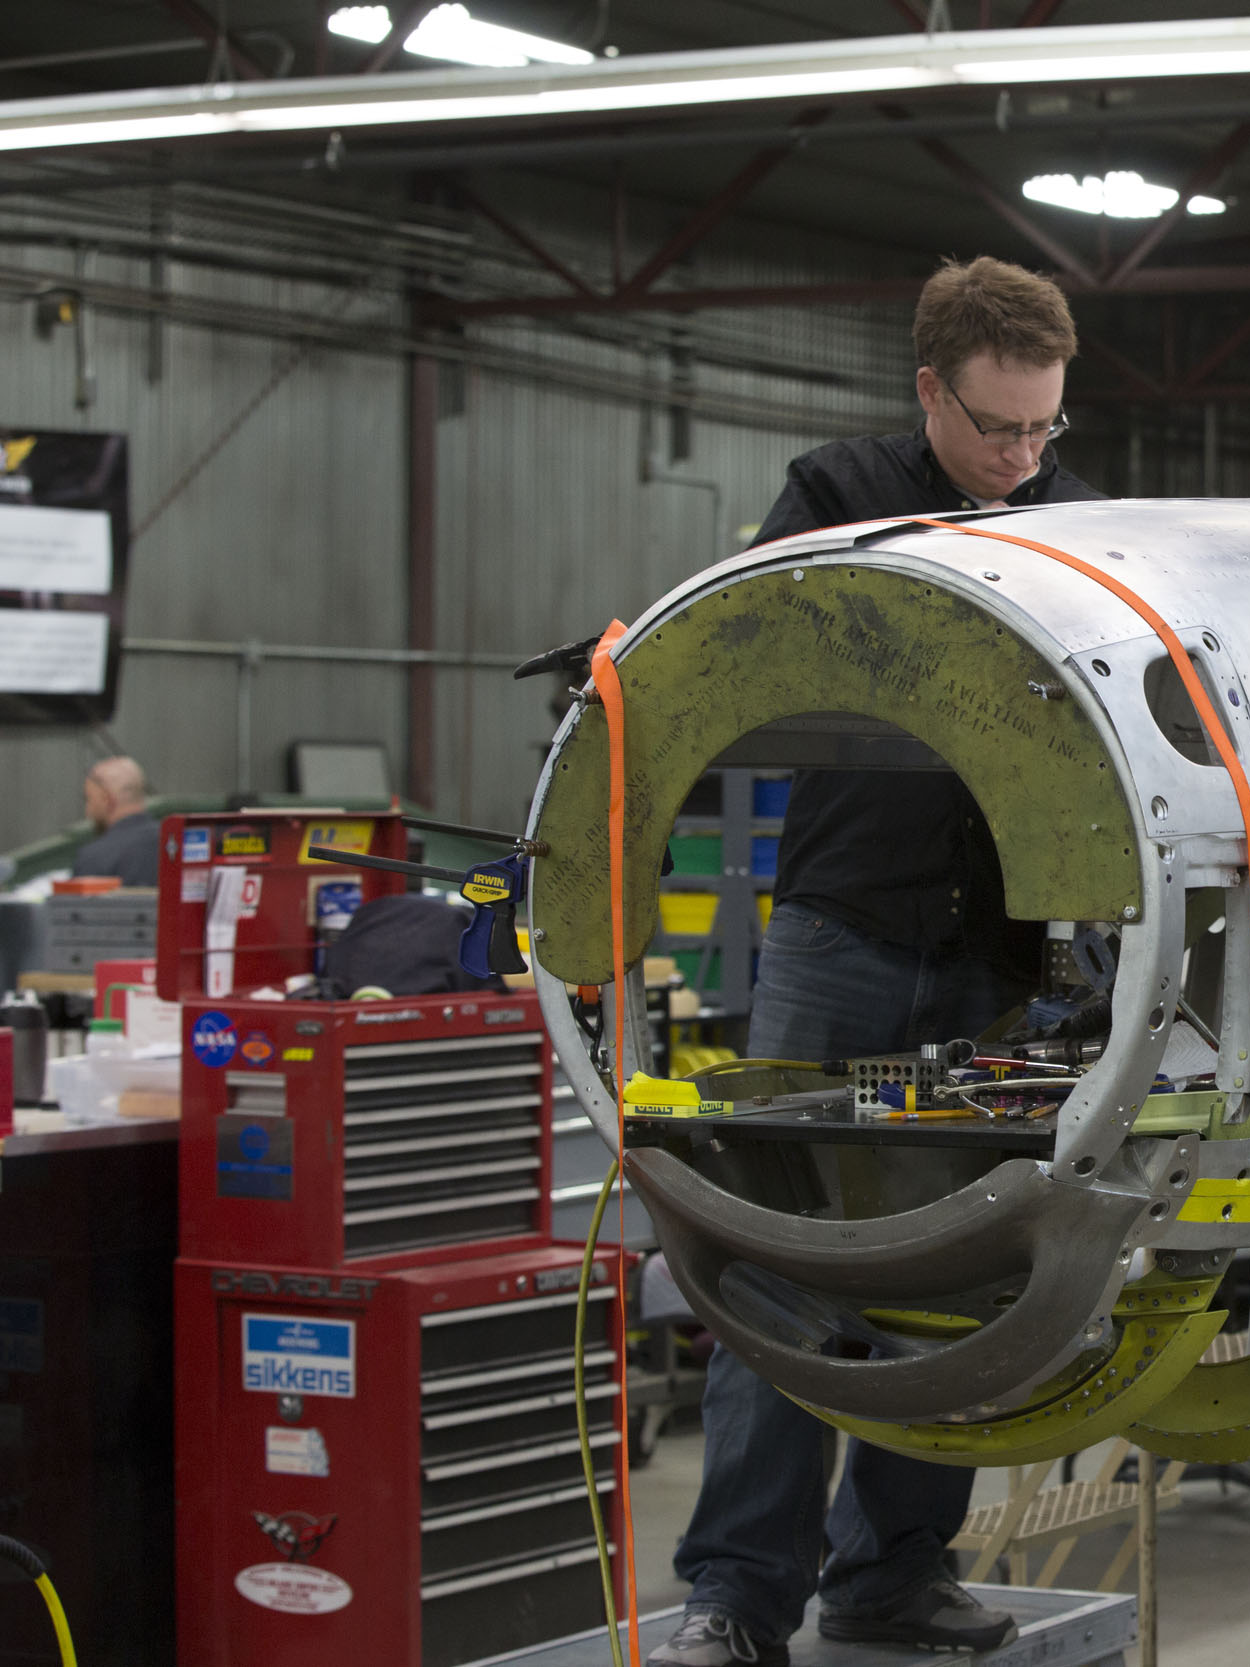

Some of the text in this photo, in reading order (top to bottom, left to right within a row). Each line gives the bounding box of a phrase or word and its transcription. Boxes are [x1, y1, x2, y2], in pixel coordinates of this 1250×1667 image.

[473, 872, 505, 888] IRWIN
[194, 1031, 236, 1047] NASA
[211, 1270, 381, 1301] CHEVROLET
[246, 1358, 350, 1394] sikkens
